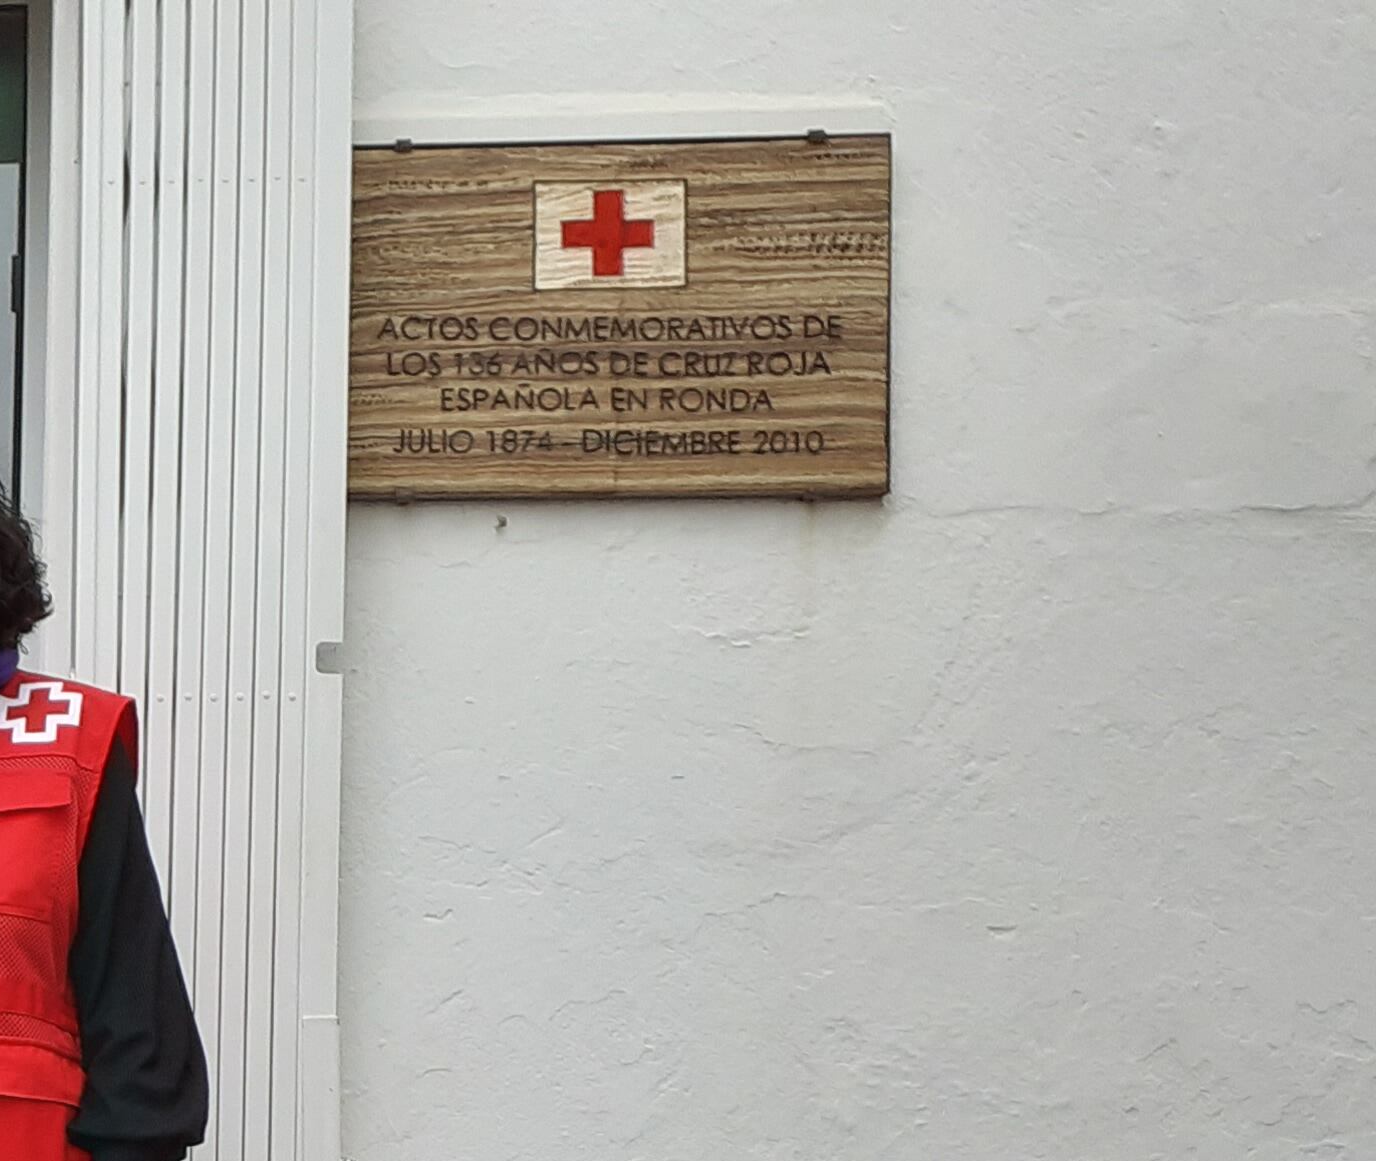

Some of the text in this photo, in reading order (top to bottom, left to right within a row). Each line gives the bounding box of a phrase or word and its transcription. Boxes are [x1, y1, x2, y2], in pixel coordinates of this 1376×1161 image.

[377, 314, 844, 342] ACTOS CONMEMORATIVOS DE
[386, 348, 832, 377] LOS 136 AÑOS DE CRUZ ROJA
[440, 382, 776, 412] ESPAÑOLA EN RONDA
[392, 428, 475, 455] JULIO
[485, 429, 553, 455] 1874
[581, 428, 741, 456] DICIEMBRE
[753, 429, 825, 455] 2010
